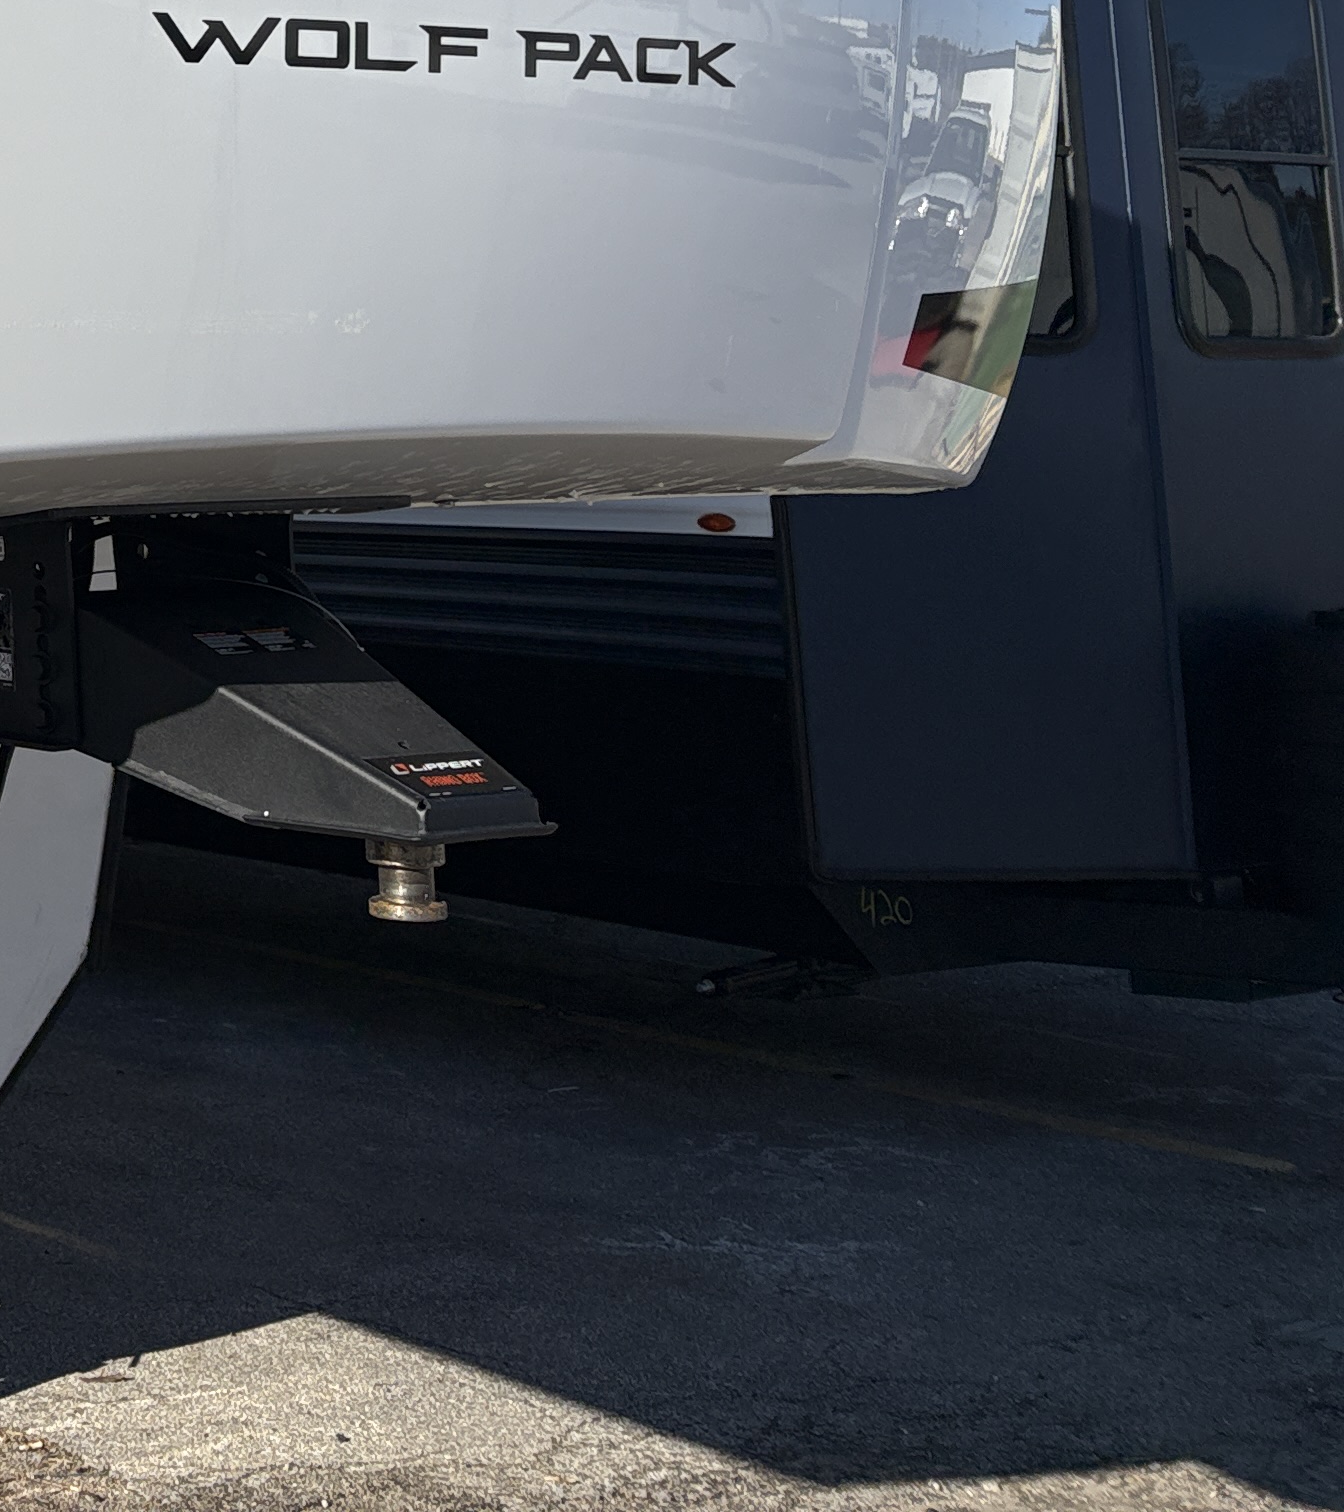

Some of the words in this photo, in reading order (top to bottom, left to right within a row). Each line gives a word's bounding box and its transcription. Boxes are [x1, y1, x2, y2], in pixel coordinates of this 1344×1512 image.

[152, 11, 488, 74] WOLF
[515, 29, 736, 88] PACK
[409, 758, 484, 772] LIPPERT
[860, 886, 913, 929] 420
